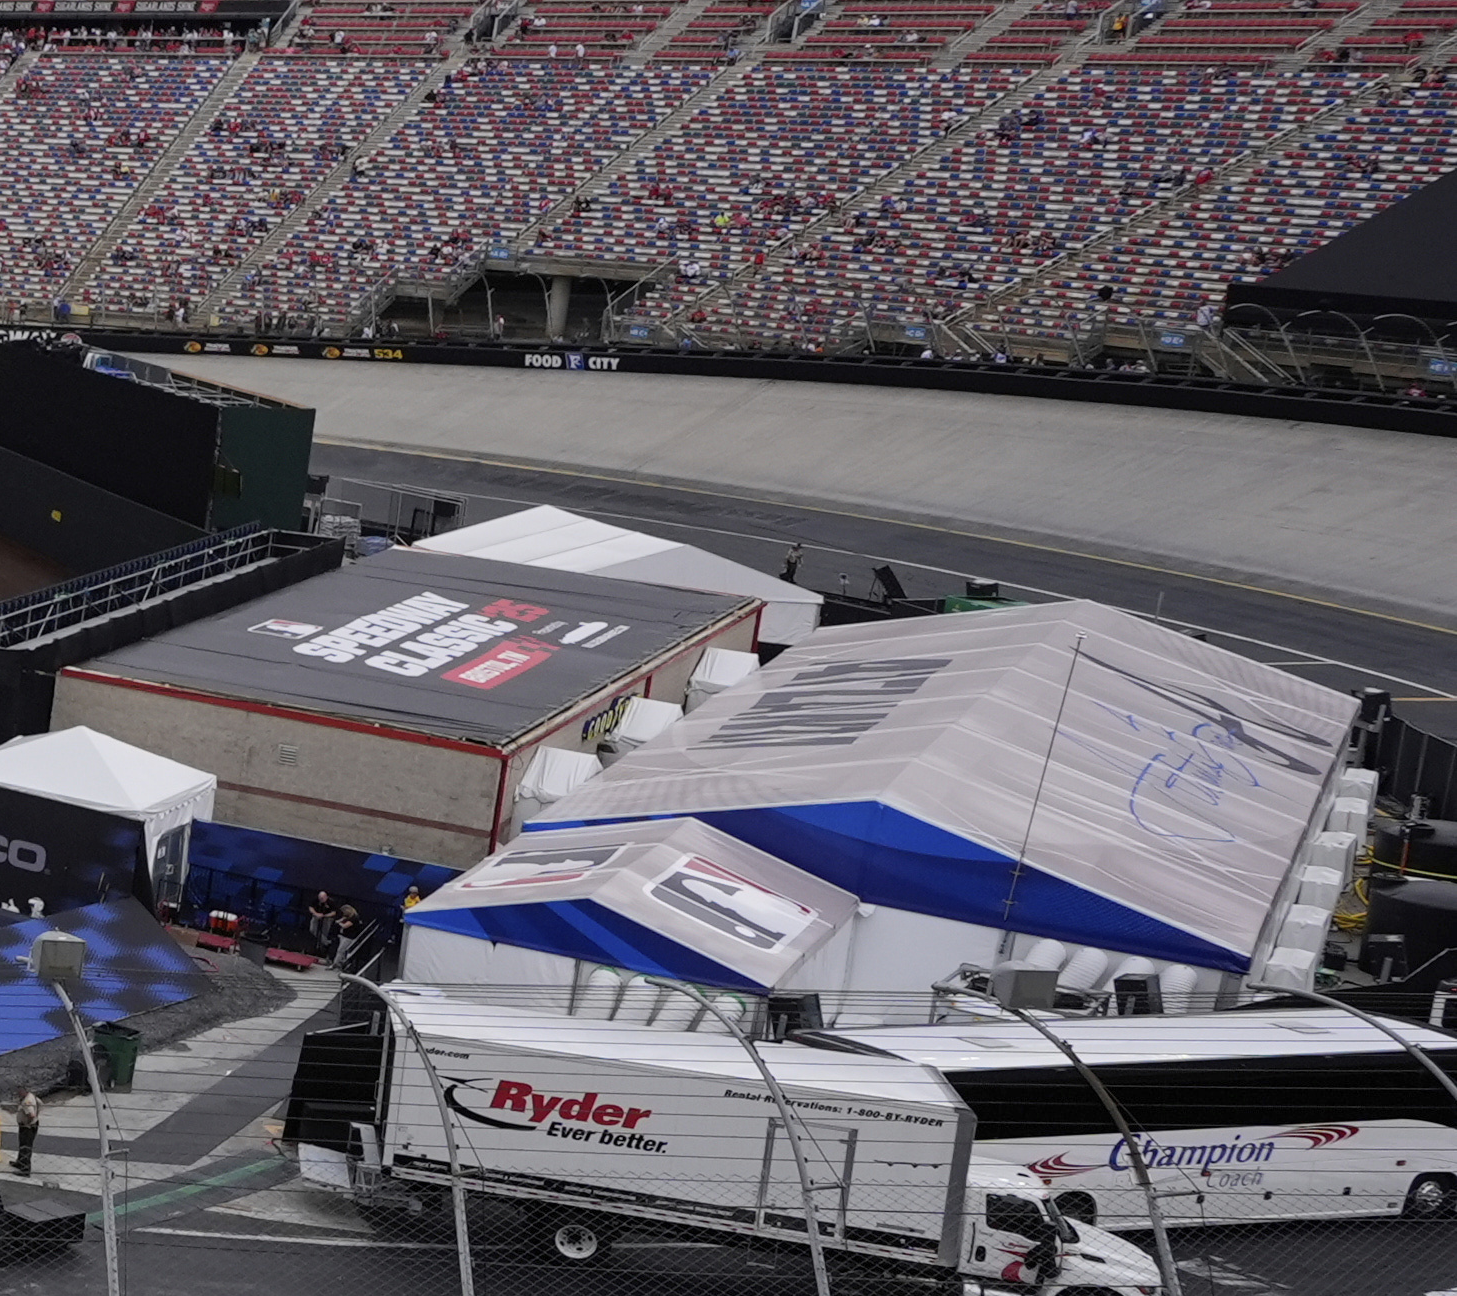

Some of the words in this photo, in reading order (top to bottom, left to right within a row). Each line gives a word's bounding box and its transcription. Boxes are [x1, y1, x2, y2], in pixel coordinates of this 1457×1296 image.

[374, 348, 403, 359] 534
[524, 354, 562, 368] FOOD
[588, 356, 620, 371] CITY
[292, 591, 470, 663] SPEEDWAY
[365, 614, 518, 677] CLASSIC
[490, 1080, 652, 1129] Ryder
[724, 1088, 762, 1103] Rental
[846, 1106, 944, 1127] 1-800-BY-RYDER
[547, 1121, 592, 1141] Ever
[599, 1130, 668, 1154] better.
[1109, 1132, 1274, 1177] Champion
[1206, 1165, 1263, 1187] Coach
